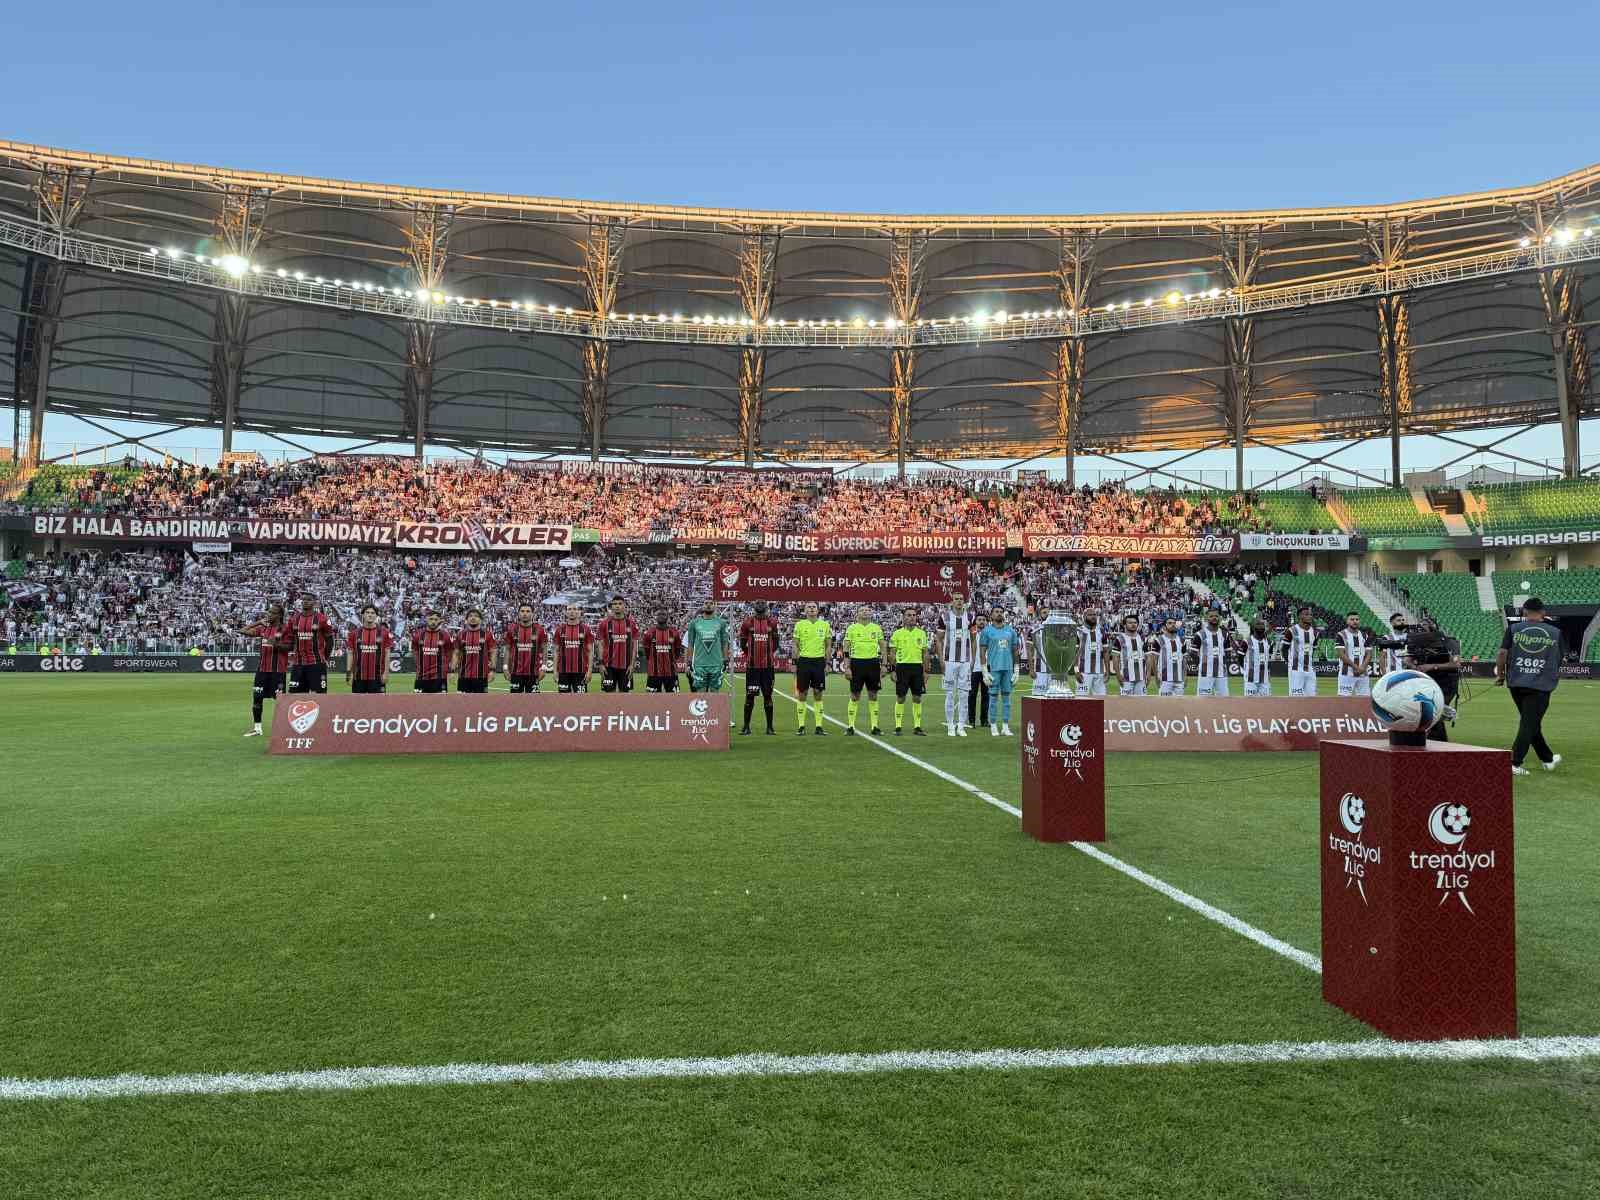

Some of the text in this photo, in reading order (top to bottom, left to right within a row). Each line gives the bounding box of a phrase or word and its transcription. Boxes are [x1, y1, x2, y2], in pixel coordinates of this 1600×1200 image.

[34, 514, 229, 538] BİZ HALA BANDIRMA
[248, 522, 392, 544] VAPURUNDAYIZ
[764, 532, 781, 549] BU
[902, 535, 1005, 550] BORDO CEPHE
[1029, 535, 1073, 551] YOK
[747, 575, 930, 589] trendyol 1. LİG PLAY-OFF FİNALİ
[720, 590, 739, 598] TFF
[40, 657, 246, 671] ette SPORTSWEAR ette
[332, 710, 670, 737] trendyol 1. LİG PLAY-OFF FİNALİ
[680, 716, 719, 728] trendyol
[1194, 718, 1208, 733] 1.
[1213, 714, 1242, 733] LİG
[1247, 717, 1331, 734] PLAY-OFF
[1336, 713, 1388, 733] FİNAL
[286, 738, 315, 749] TFF
[1050, 748, 1095, 761] trendyol
[1329, 833, 1381, 864] trendyol
[1409, 850, 1495, 872] trendyol
